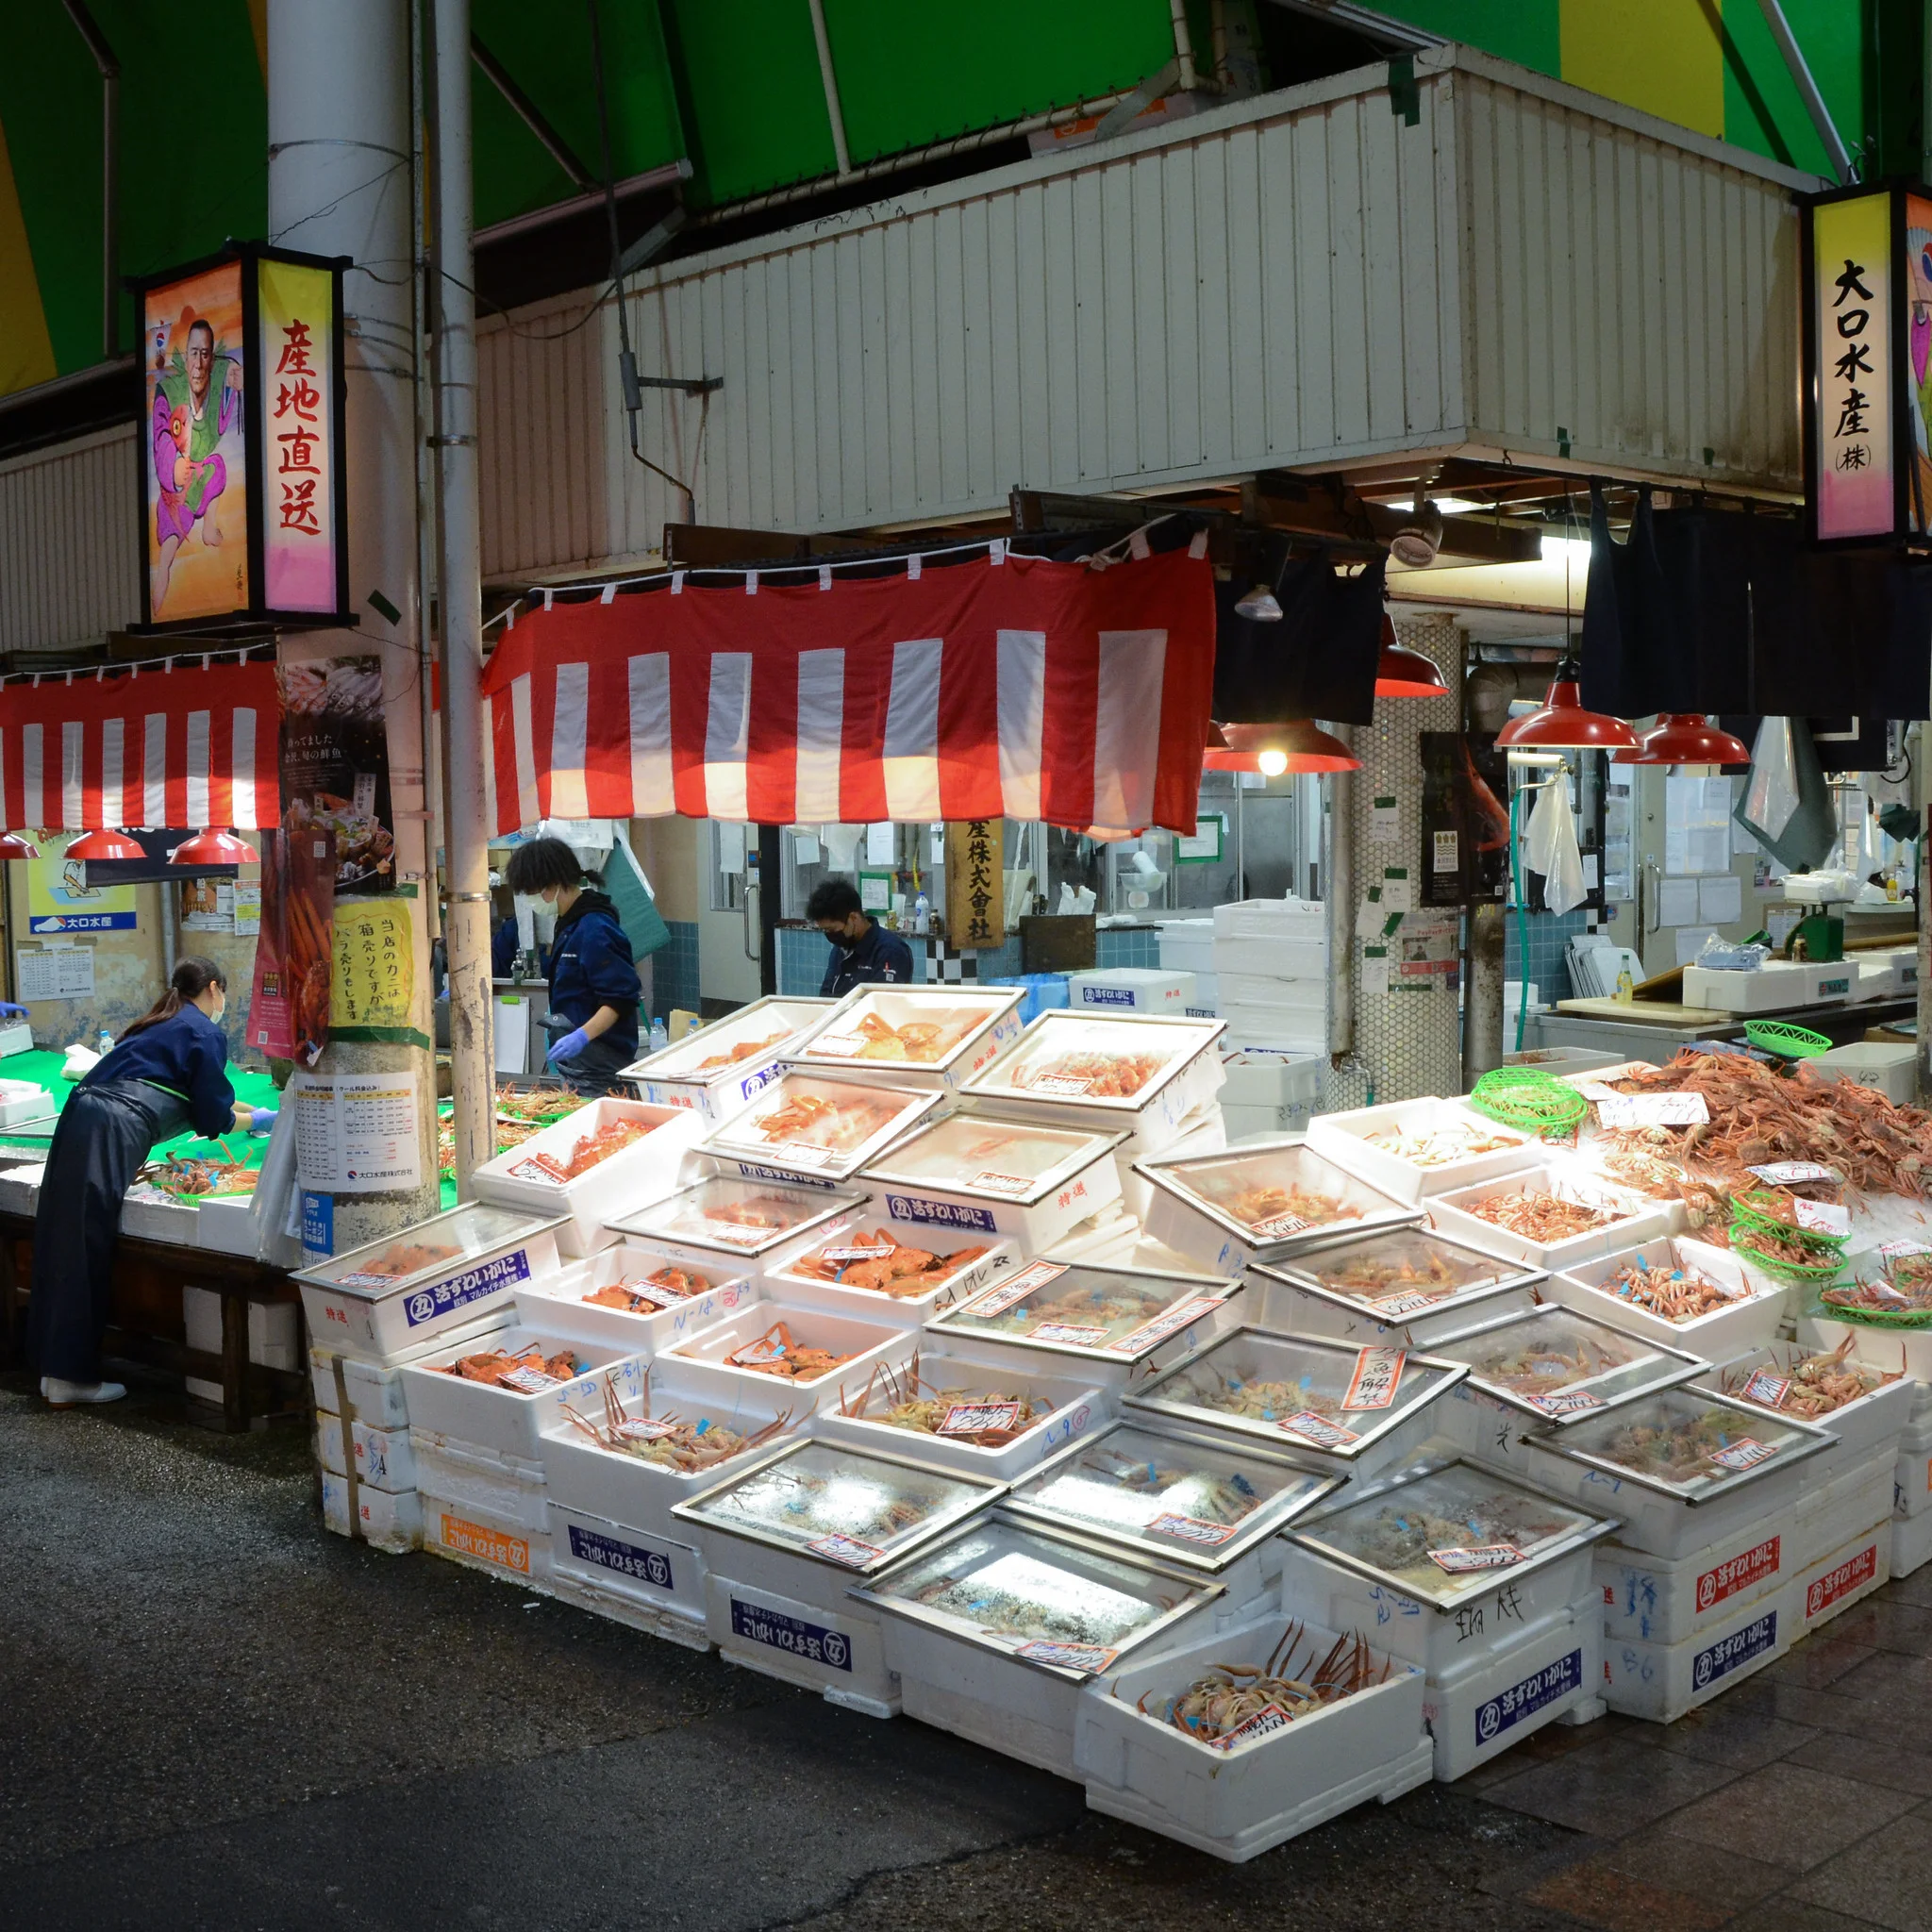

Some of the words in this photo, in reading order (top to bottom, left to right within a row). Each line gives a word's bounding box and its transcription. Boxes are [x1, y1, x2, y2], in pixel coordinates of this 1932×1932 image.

[274, 319, 322, 536] 産地直送
[67, 917, 112, 928] 大口水産
[358, 924, 384, 1006] 箱売りですが
[382, 920, 401, 998] 当店のカニは
[359, 1169, 412, 1179] 大口水産株式会社
[911, 1198, 985, 1225] 活ずわいがに
[434, 1257, 517, 1304] 活ずわいがに
[1718, 1541, 1774, 1589] 活ずわいがに
[742, 1616, 822, 1660] 活ずわいがに
[1714, 1618, 1770, 1667] 活ずわいがに
[1502, 1657, 1572, 1716] 活ずわいがに
